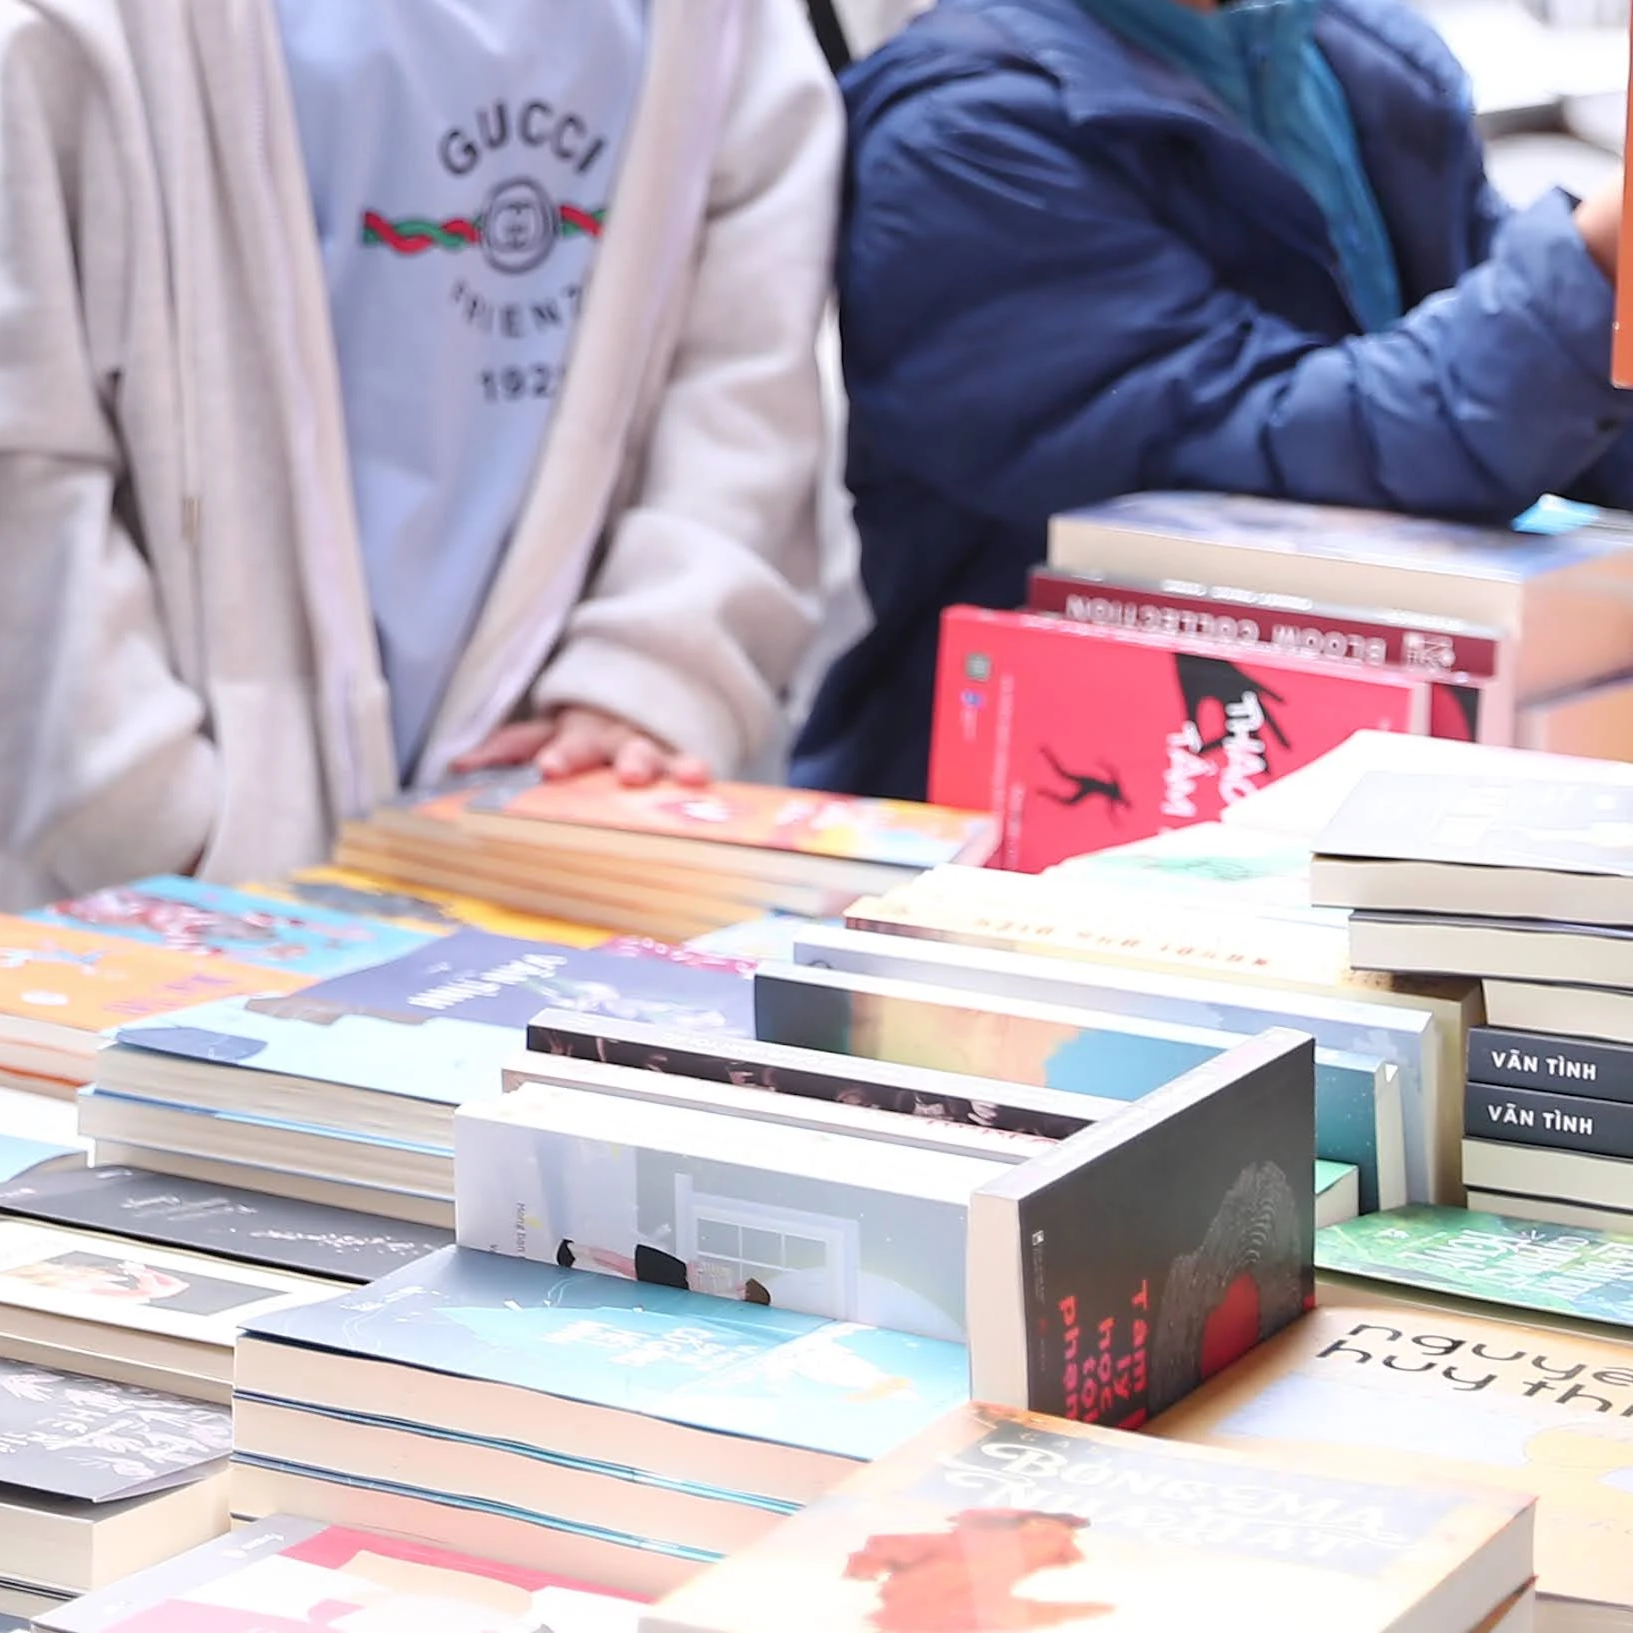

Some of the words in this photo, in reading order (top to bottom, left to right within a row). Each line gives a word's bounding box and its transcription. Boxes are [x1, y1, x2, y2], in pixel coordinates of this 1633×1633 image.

[439, 99, 607, 176] GUCCI
[481, 364, 563, 403] 192
[1065, 594, 1261, 644] COLLECTION
[1272, 622, 1387, 666] BLOOM
[1492, 1049, 1539, 1073] VÃN
[1546, 1055, 1597, 1081] TÌNH
[1488, 1103, 1535, 1127] VÃN
[1543, 1109, 1593, 1135] TÌNH
[1316, 1338, 1498, 1392] huy
